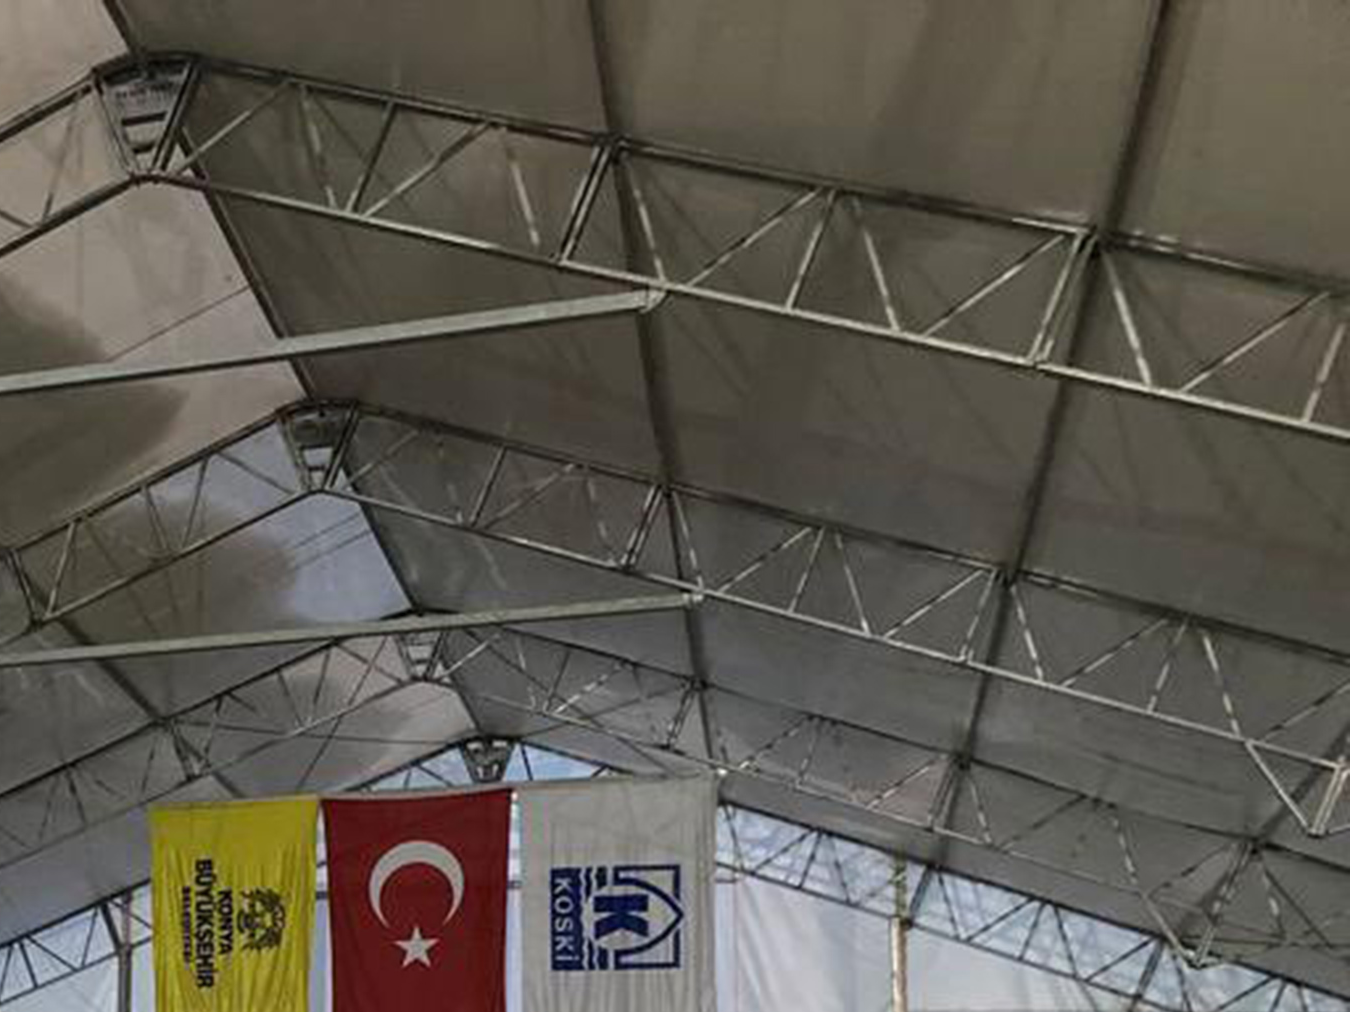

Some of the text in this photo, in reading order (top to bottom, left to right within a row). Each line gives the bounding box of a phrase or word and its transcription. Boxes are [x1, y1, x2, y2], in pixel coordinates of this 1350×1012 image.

[193, 859, 217, 988] BÜYÜKŞEHİR
[217, 888, 232, 954] KONYA
[554, 878, 579, 960] KOSKİ
